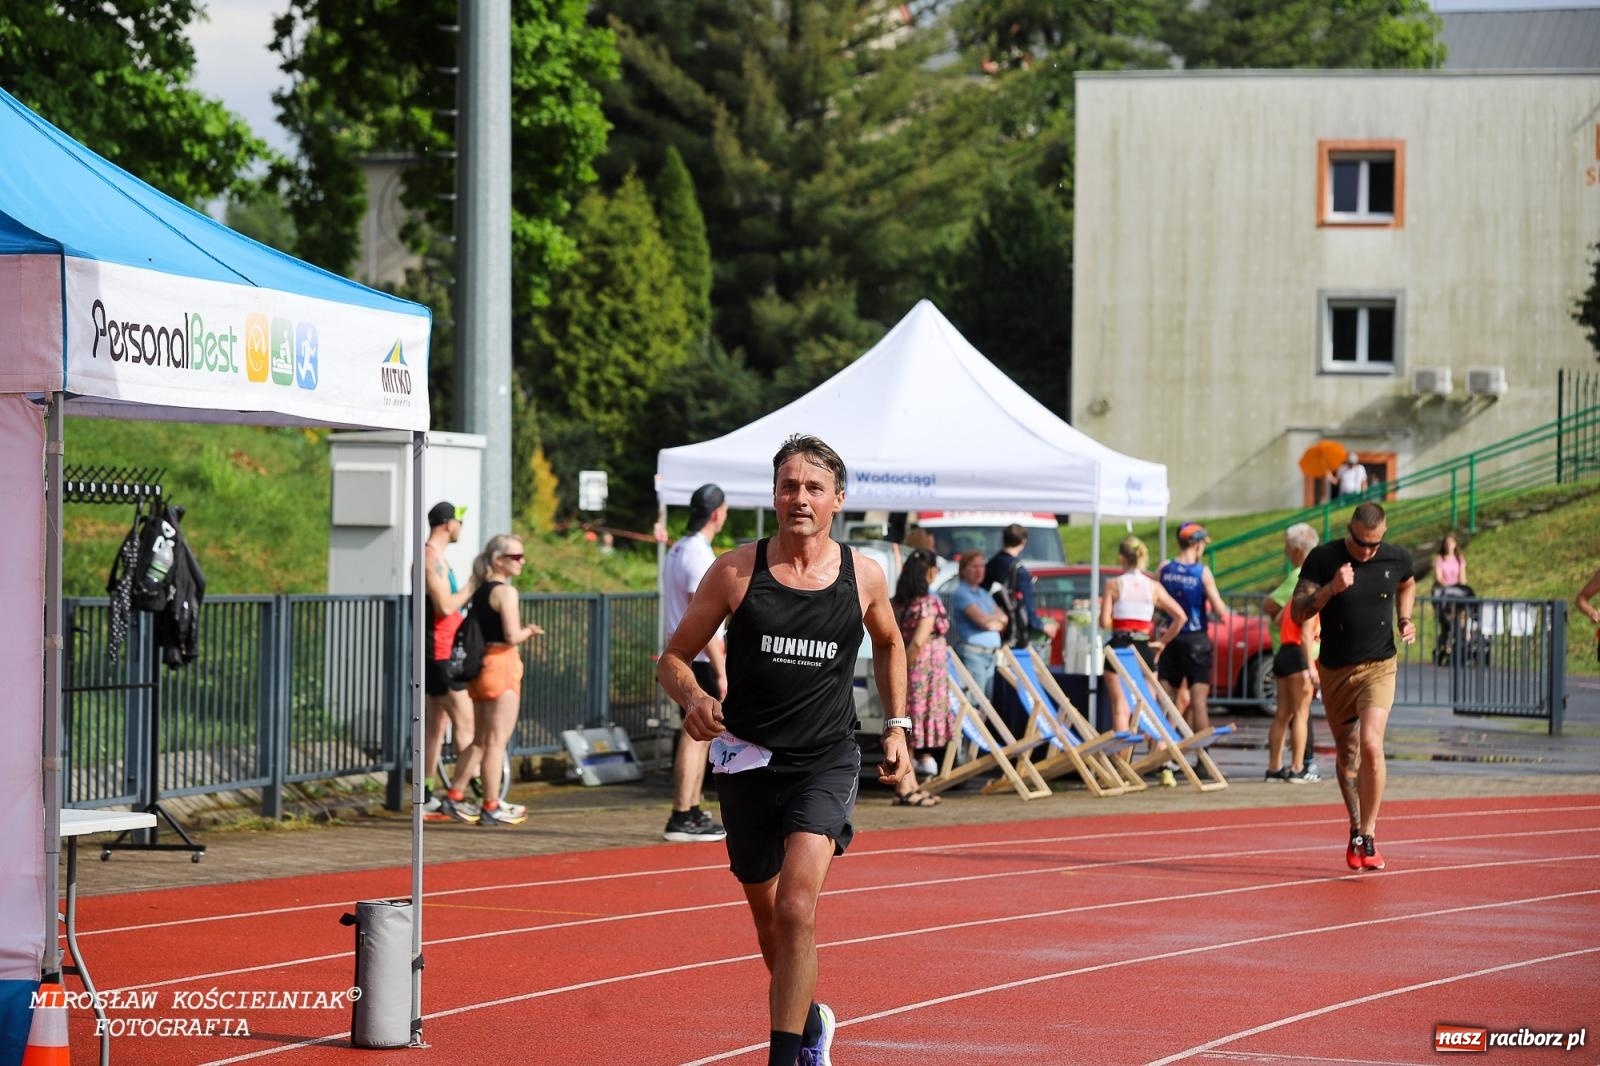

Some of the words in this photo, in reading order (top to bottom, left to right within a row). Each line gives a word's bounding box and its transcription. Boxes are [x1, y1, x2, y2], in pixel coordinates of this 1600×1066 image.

[381, 367, 412, 395] MITKO
[856, 472, 936, 487] Wodociągi
[760, 634, 838, 659] RUNNING
[772, 657, 796, 665] AEROBIC
[797, 659, 822, 667] EXERCISE
